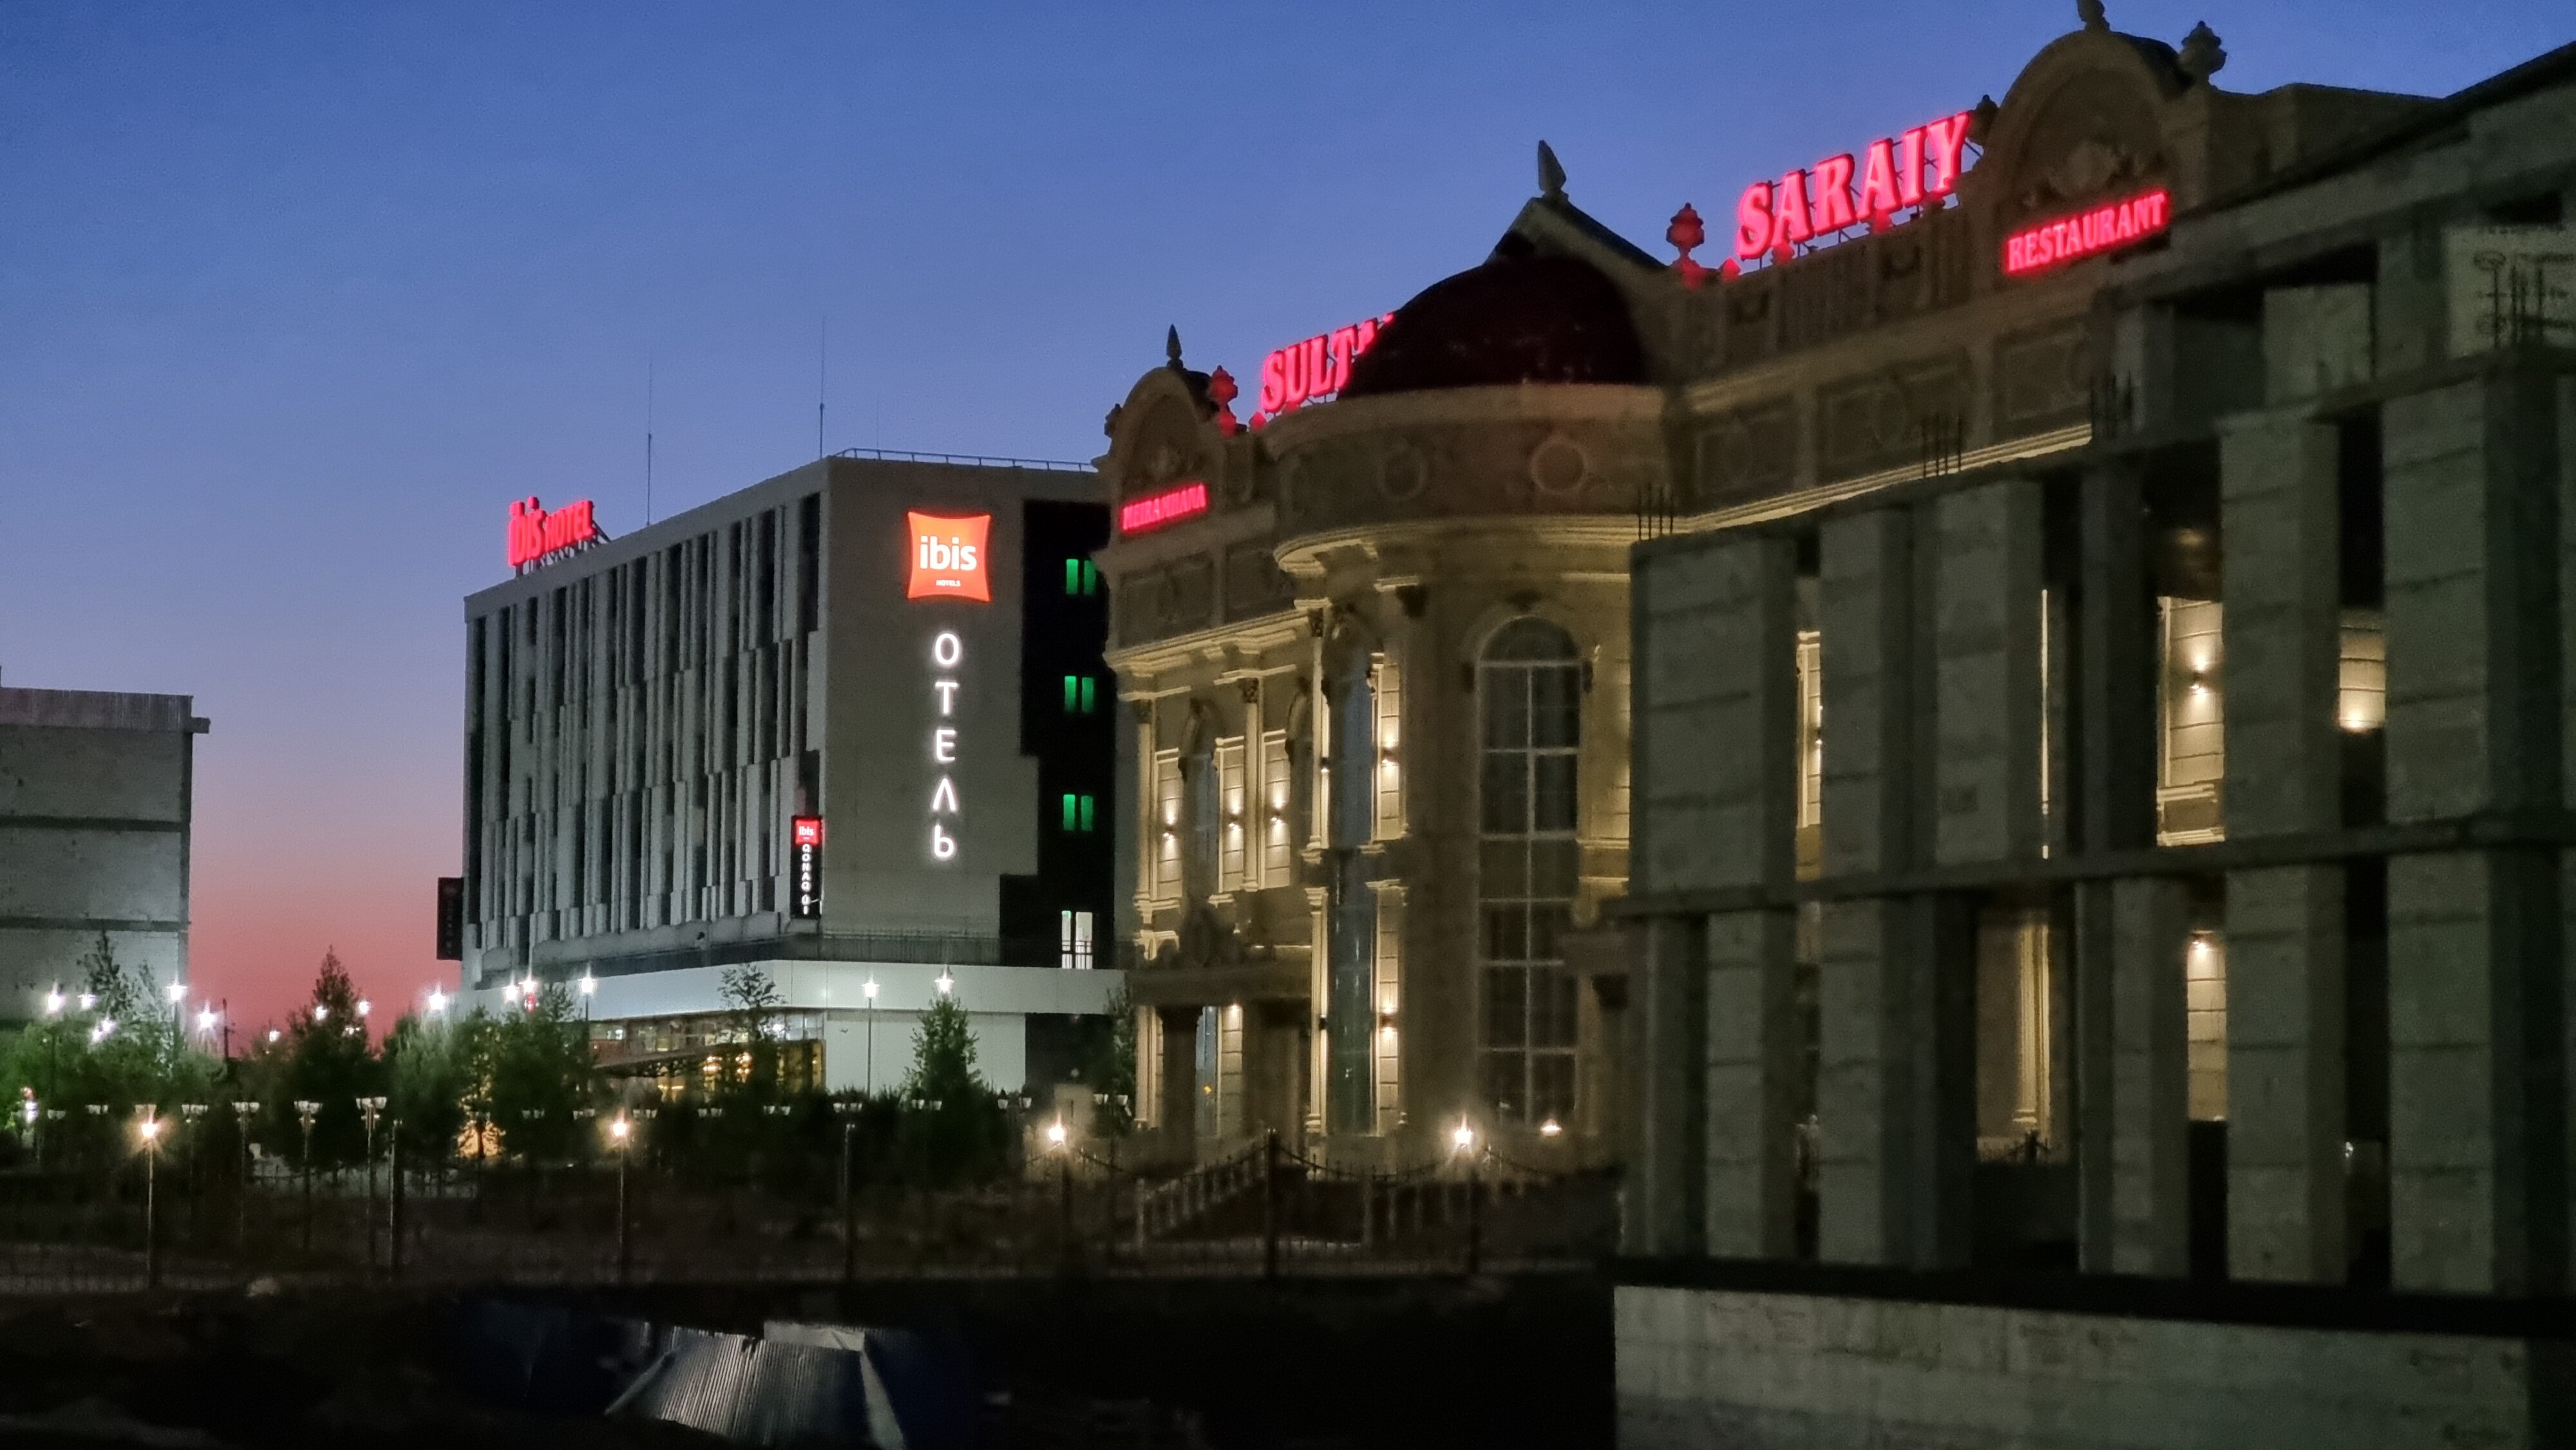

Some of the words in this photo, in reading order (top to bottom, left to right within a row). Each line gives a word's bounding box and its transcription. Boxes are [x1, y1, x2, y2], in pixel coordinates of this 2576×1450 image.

[1735, 111, 1971, 259] SARAIY
[2007, 193, 2168, 273] RESTAURANT
[545, 500, 595, 552] HOTEL
[920, 535, 977, 571] ibis
[799, 826, 814, 836] ibis
